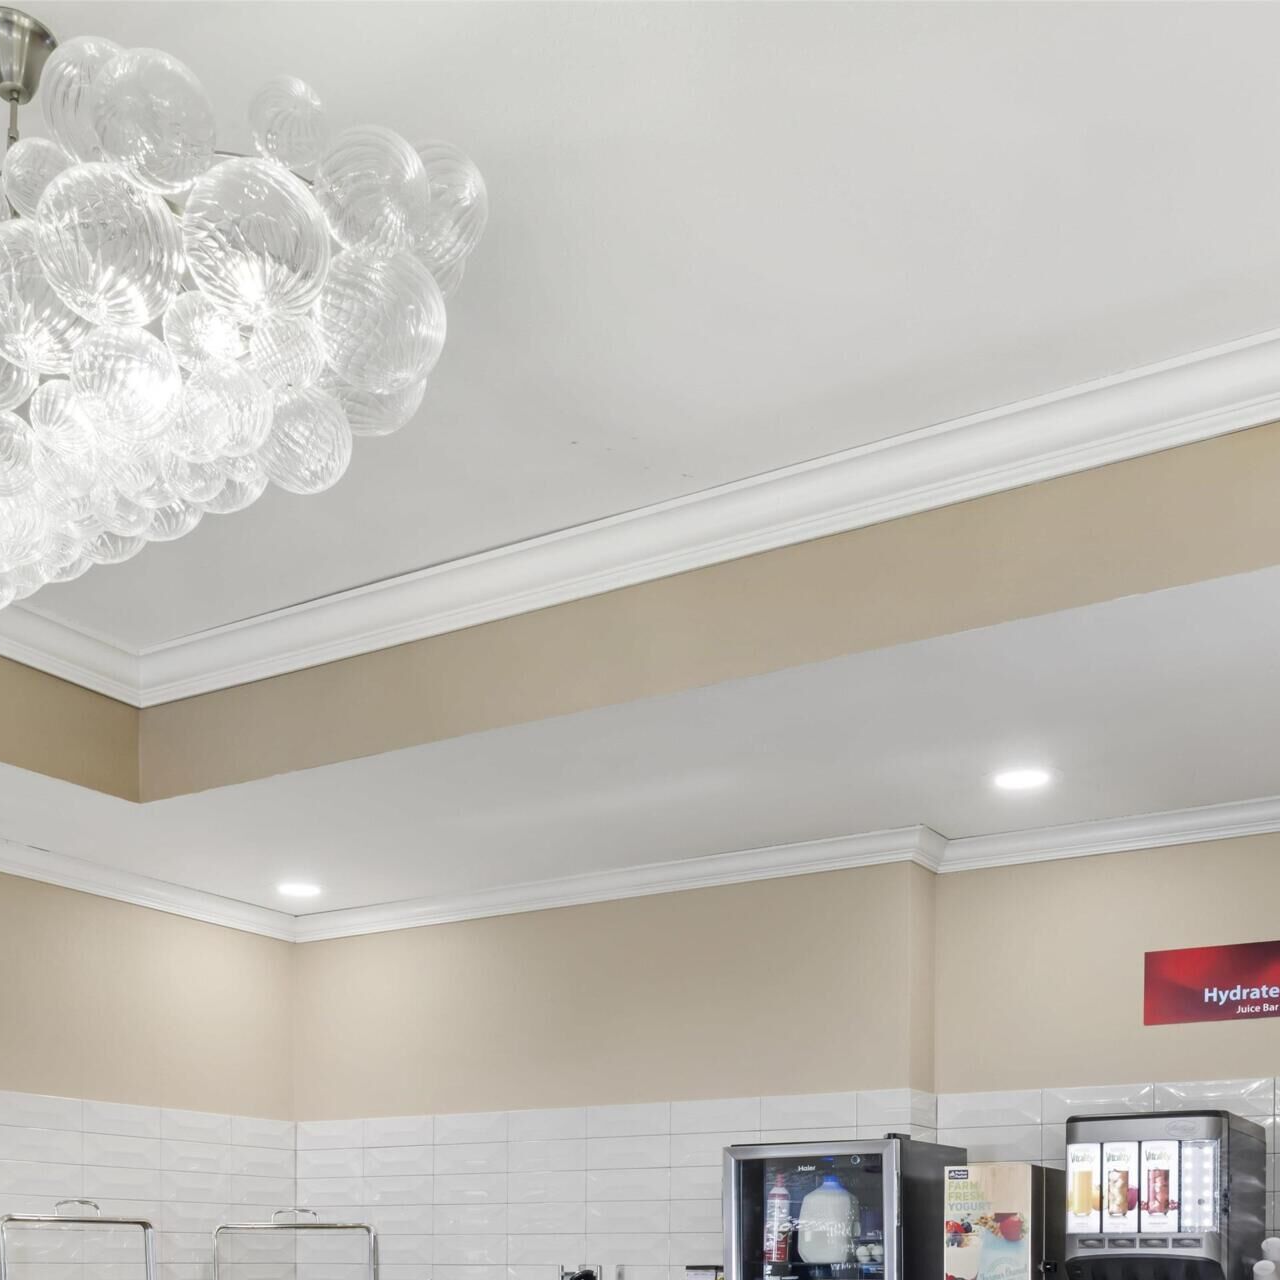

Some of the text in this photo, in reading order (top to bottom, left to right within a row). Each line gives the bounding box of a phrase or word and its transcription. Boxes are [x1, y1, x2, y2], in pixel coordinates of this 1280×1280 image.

[1204, 985, 1280, 1006] Hydrate
[1236, 1003, 1279, 1014] Juice Bar
[1071, 1152, 1095, 1163] Vitality
[1106, 1151, 1130, 1162] Vitality
[1145, 1150, 1170, 1162] Vitality
[948, 1181, 978, 1190] FARM
[948, 1192, 985, 1200] FRESH
[948, 1202, 992, 1211] YOGURT
